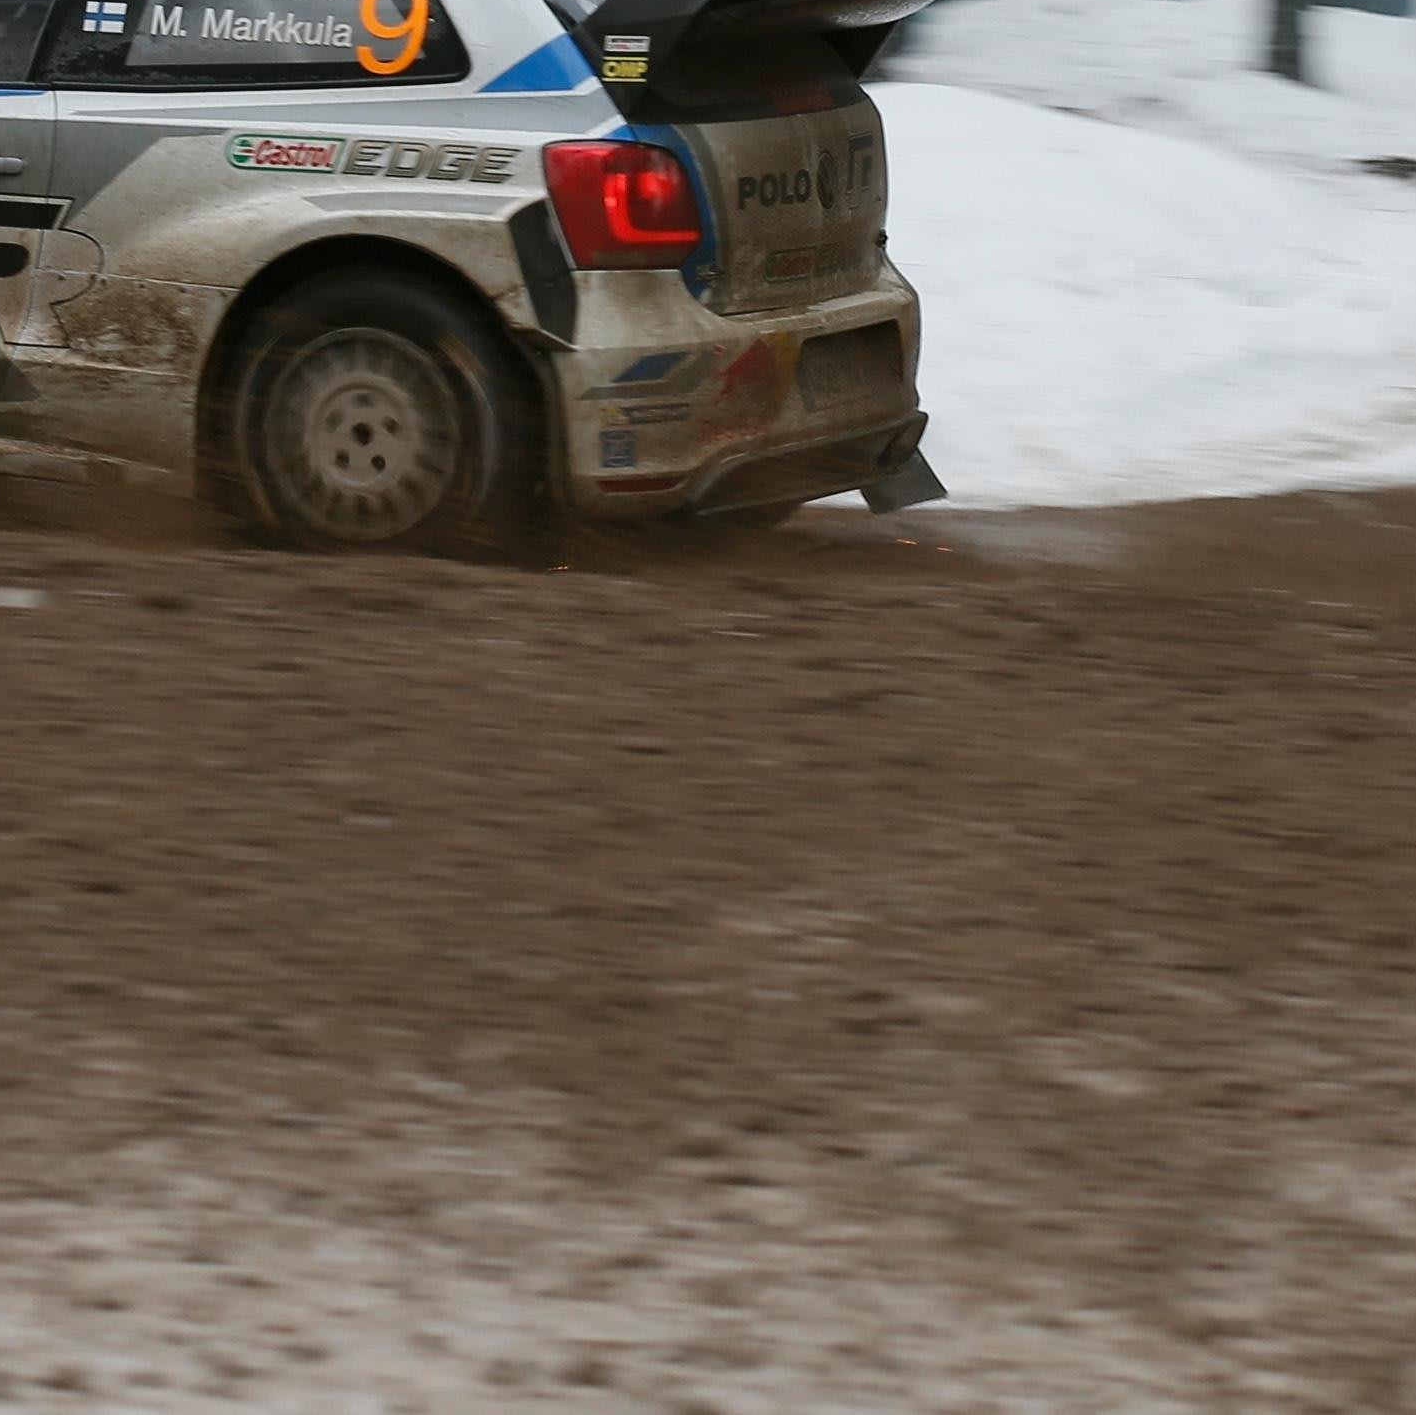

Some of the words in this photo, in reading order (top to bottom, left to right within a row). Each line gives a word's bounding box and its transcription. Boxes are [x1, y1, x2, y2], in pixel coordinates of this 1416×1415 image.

[150, 5, 187, 37] M.
[201, 7, 353, 48] Markkula
[254, 140, 337, 167] Castrol
[342, 139, 523, 184] EDGE
[737, 169, 811, 210] POLO
